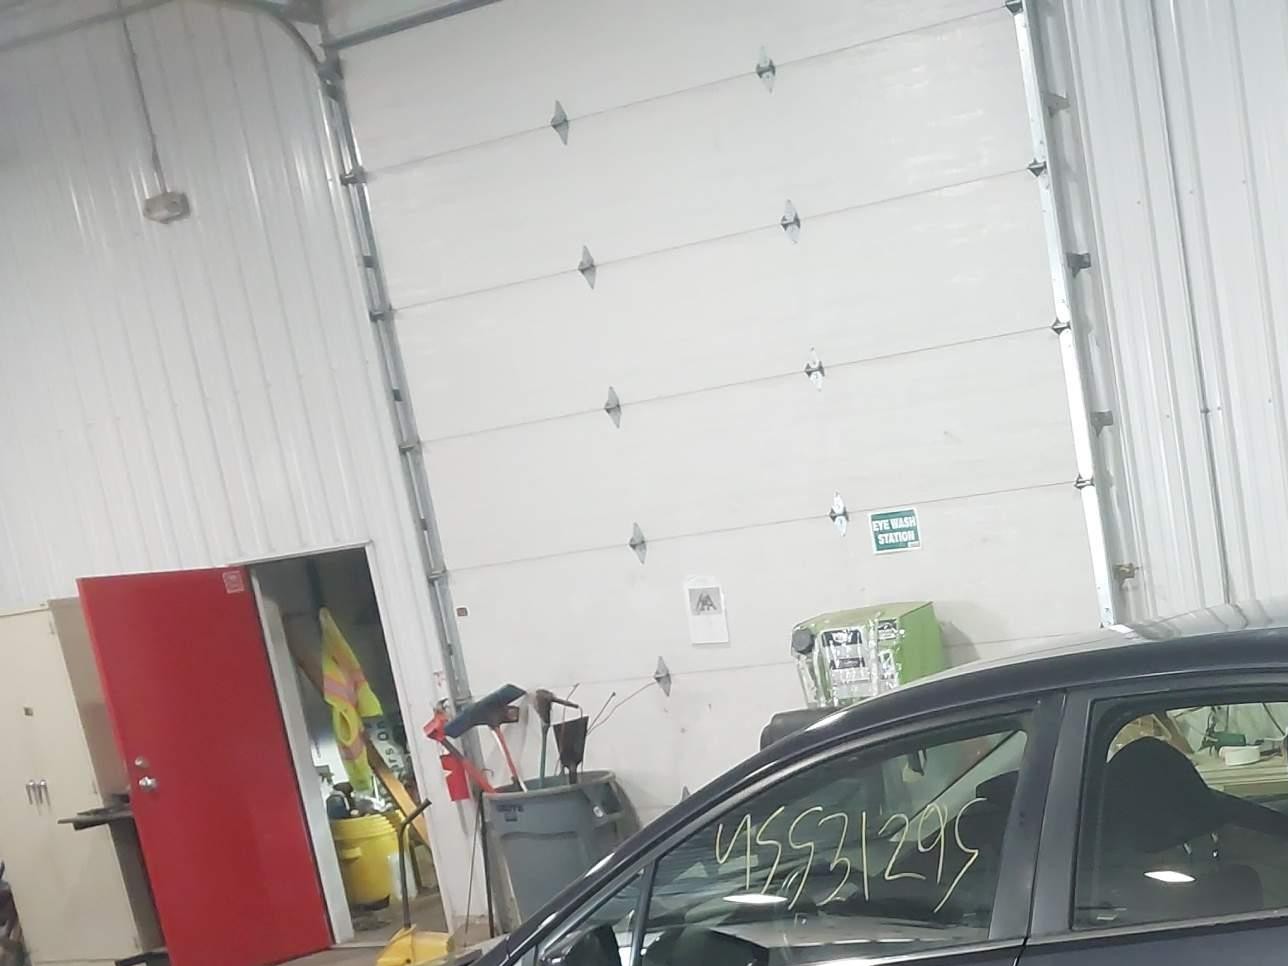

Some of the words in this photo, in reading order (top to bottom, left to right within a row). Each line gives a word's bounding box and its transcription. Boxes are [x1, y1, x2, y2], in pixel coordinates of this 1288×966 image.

[872, 520, 890, 531] EYE
[890, 516, 916, 530] WASH
[877, 530, 915, 545] STATION
[716, 798, 987, 913] 45531295
